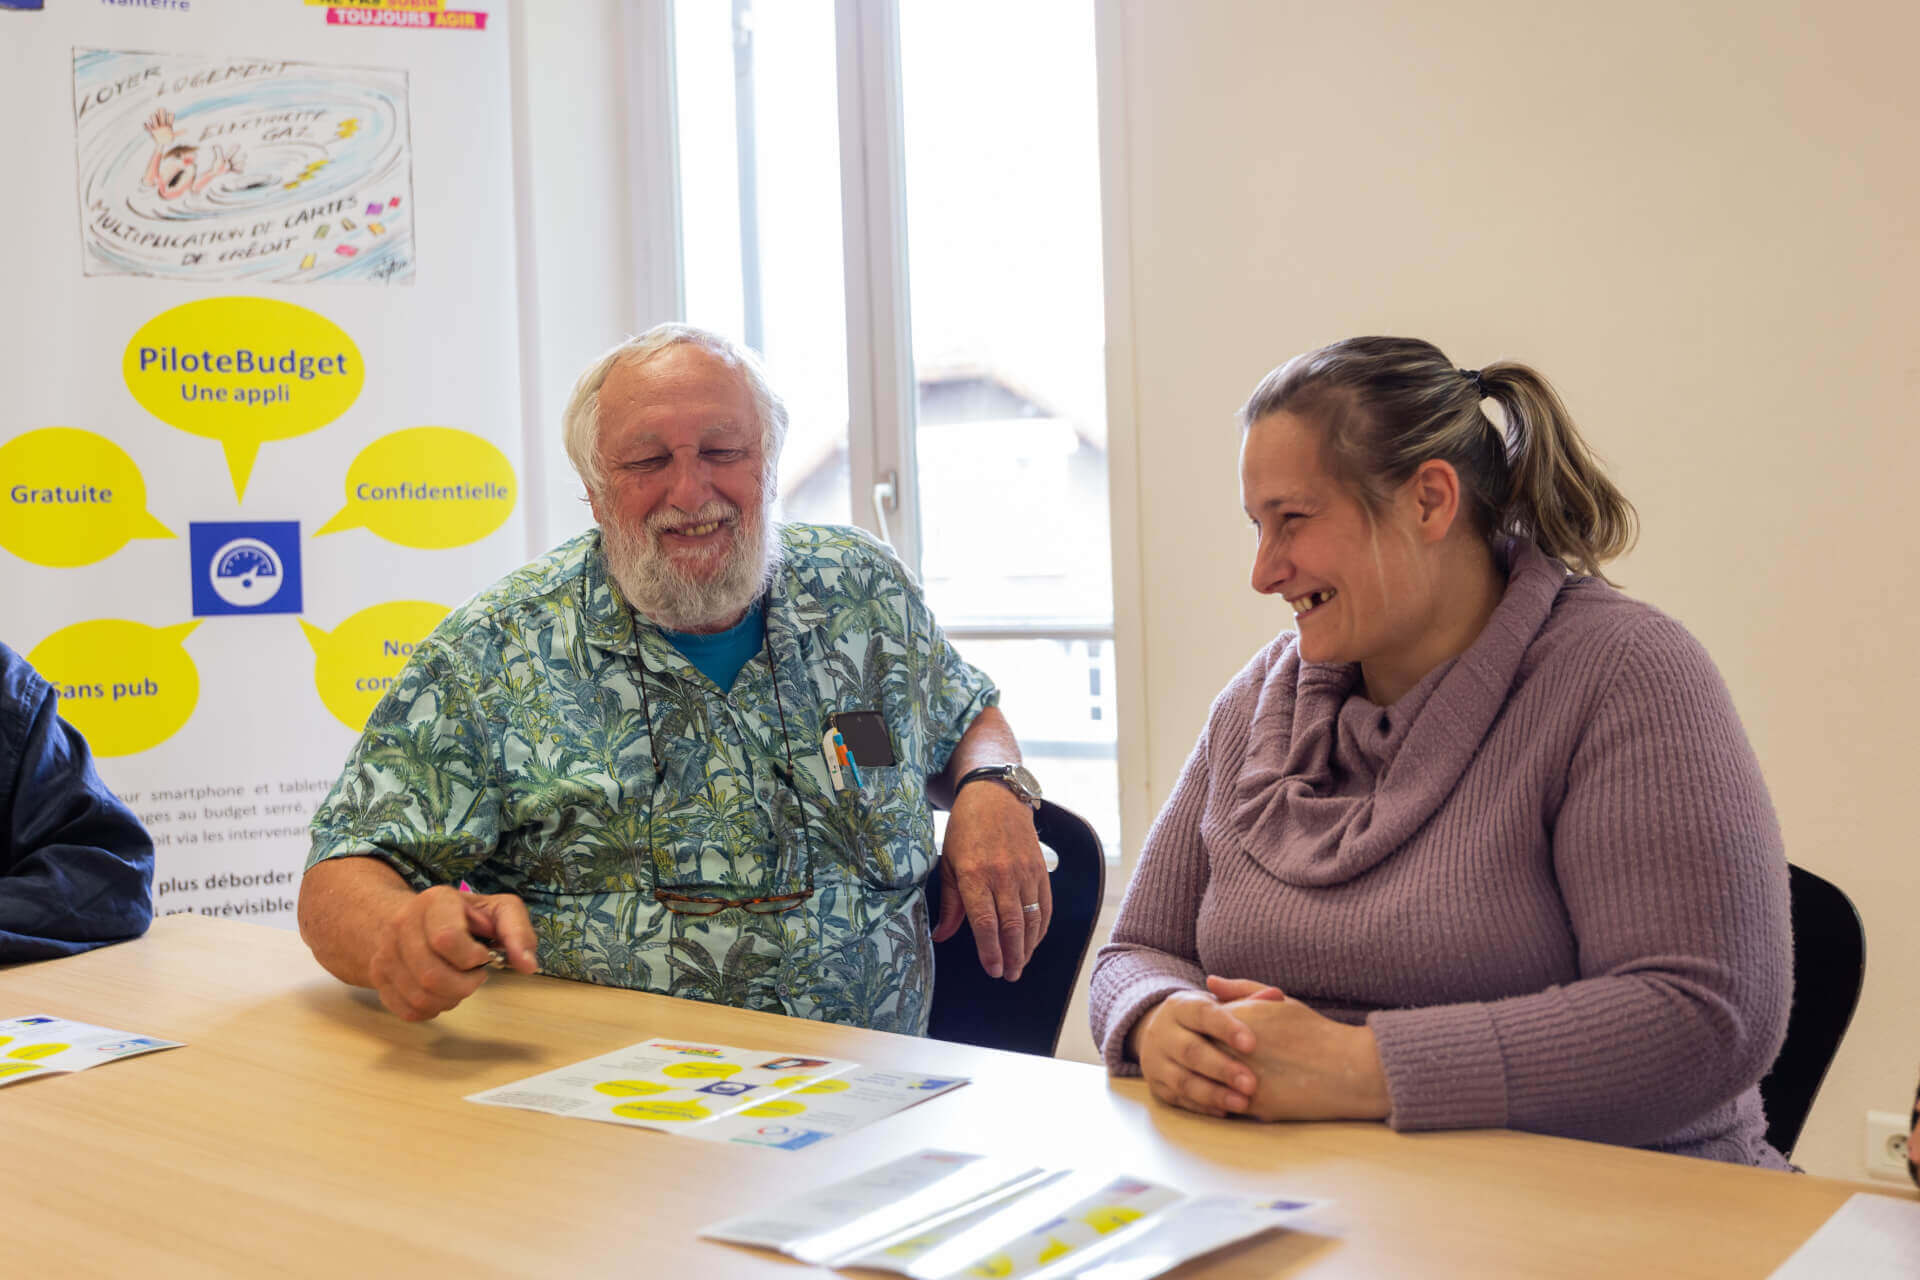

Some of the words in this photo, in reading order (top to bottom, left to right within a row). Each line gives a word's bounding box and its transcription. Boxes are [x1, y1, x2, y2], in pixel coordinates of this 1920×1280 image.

[335, 8, 431, 26] TOUJOURS
[433, 13, 477, 28] AGIR
[79, 66, 161, 119] LOYER
[157, 61, 288, 97] LOGEMENT
[90, 199, 244, 248] MULTIPLICATION
[139, 346, 348, 380] PiloteBudget
[181, 383, 228, 402] Une
[234, 384, 290, 407] appli
[10, 484, 113, 504] Gratuite
[356, 481, 509, 501] Confidentielle
[112, 676, 159, 702] pub
[151, 785, 245, 802] smartphone
[254, 783, 269, 795] et
[178, 810, 197, 821] au
[204, 805, 257, 822] budget
[176, 833, 198, 846] via
[203, 829, 224, 843] les
[159, 876, 199, 896] plus
[205, 869, 294, 890] déborder
[201, 896, 295, 917] prévisible
